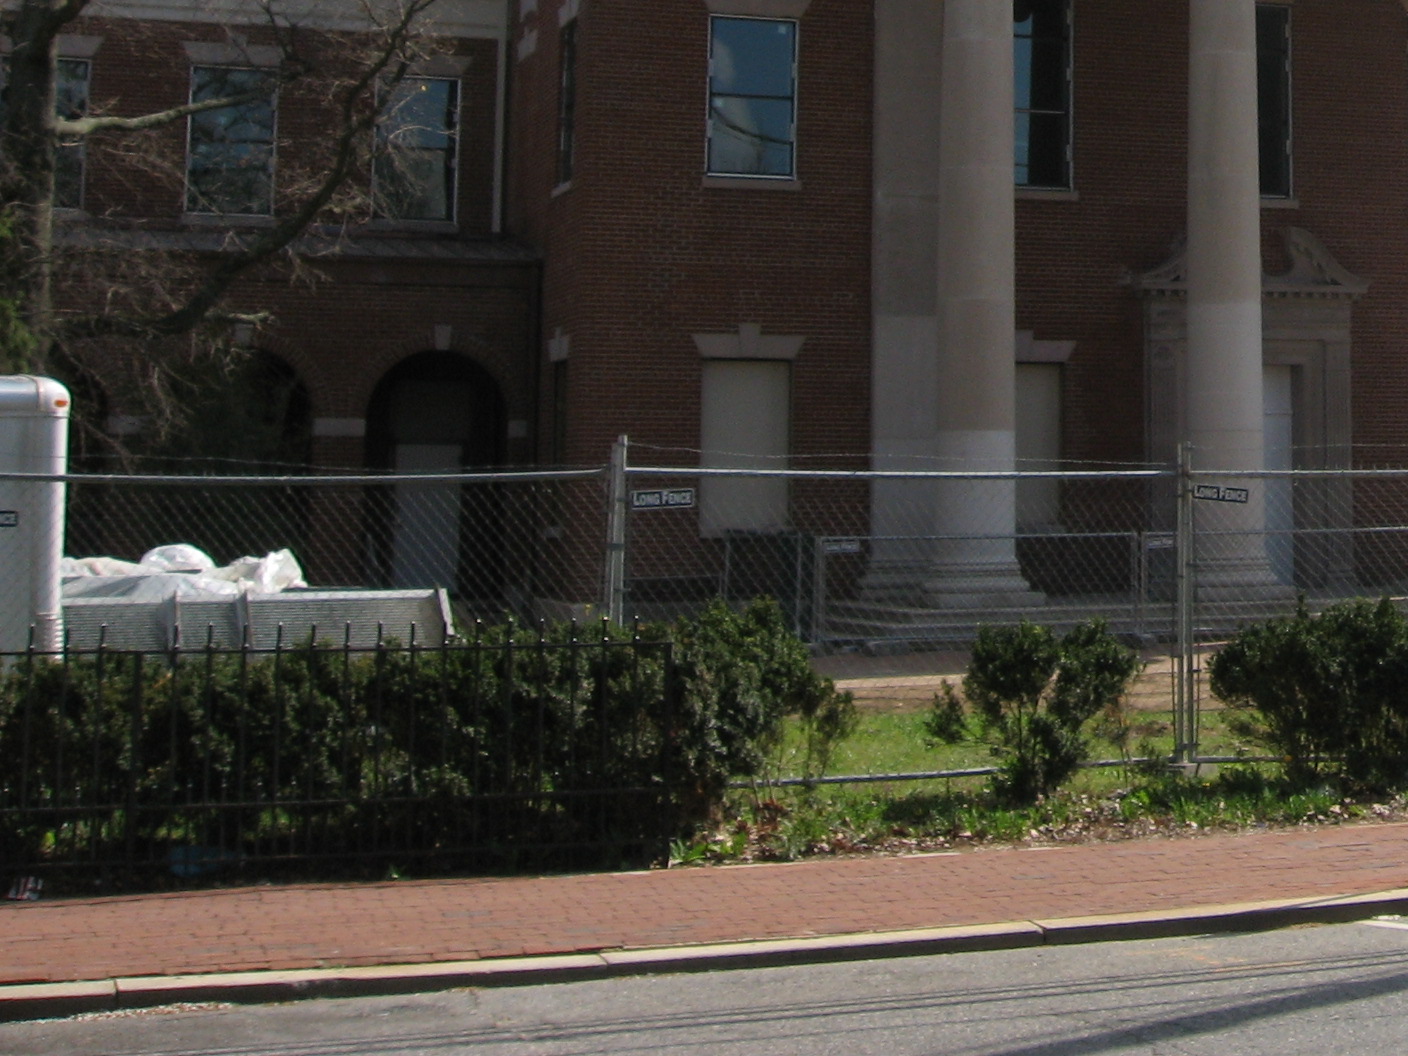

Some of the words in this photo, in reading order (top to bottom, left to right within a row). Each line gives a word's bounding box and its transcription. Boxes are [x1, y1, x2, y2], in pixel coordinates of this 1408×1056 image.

[633, 492, 660, 506] LONG
[662, 491, 692, 504] FENCE
[1194, 485, 1218, 499] LONG
[1220, 487, 1247, 502] FENCE
